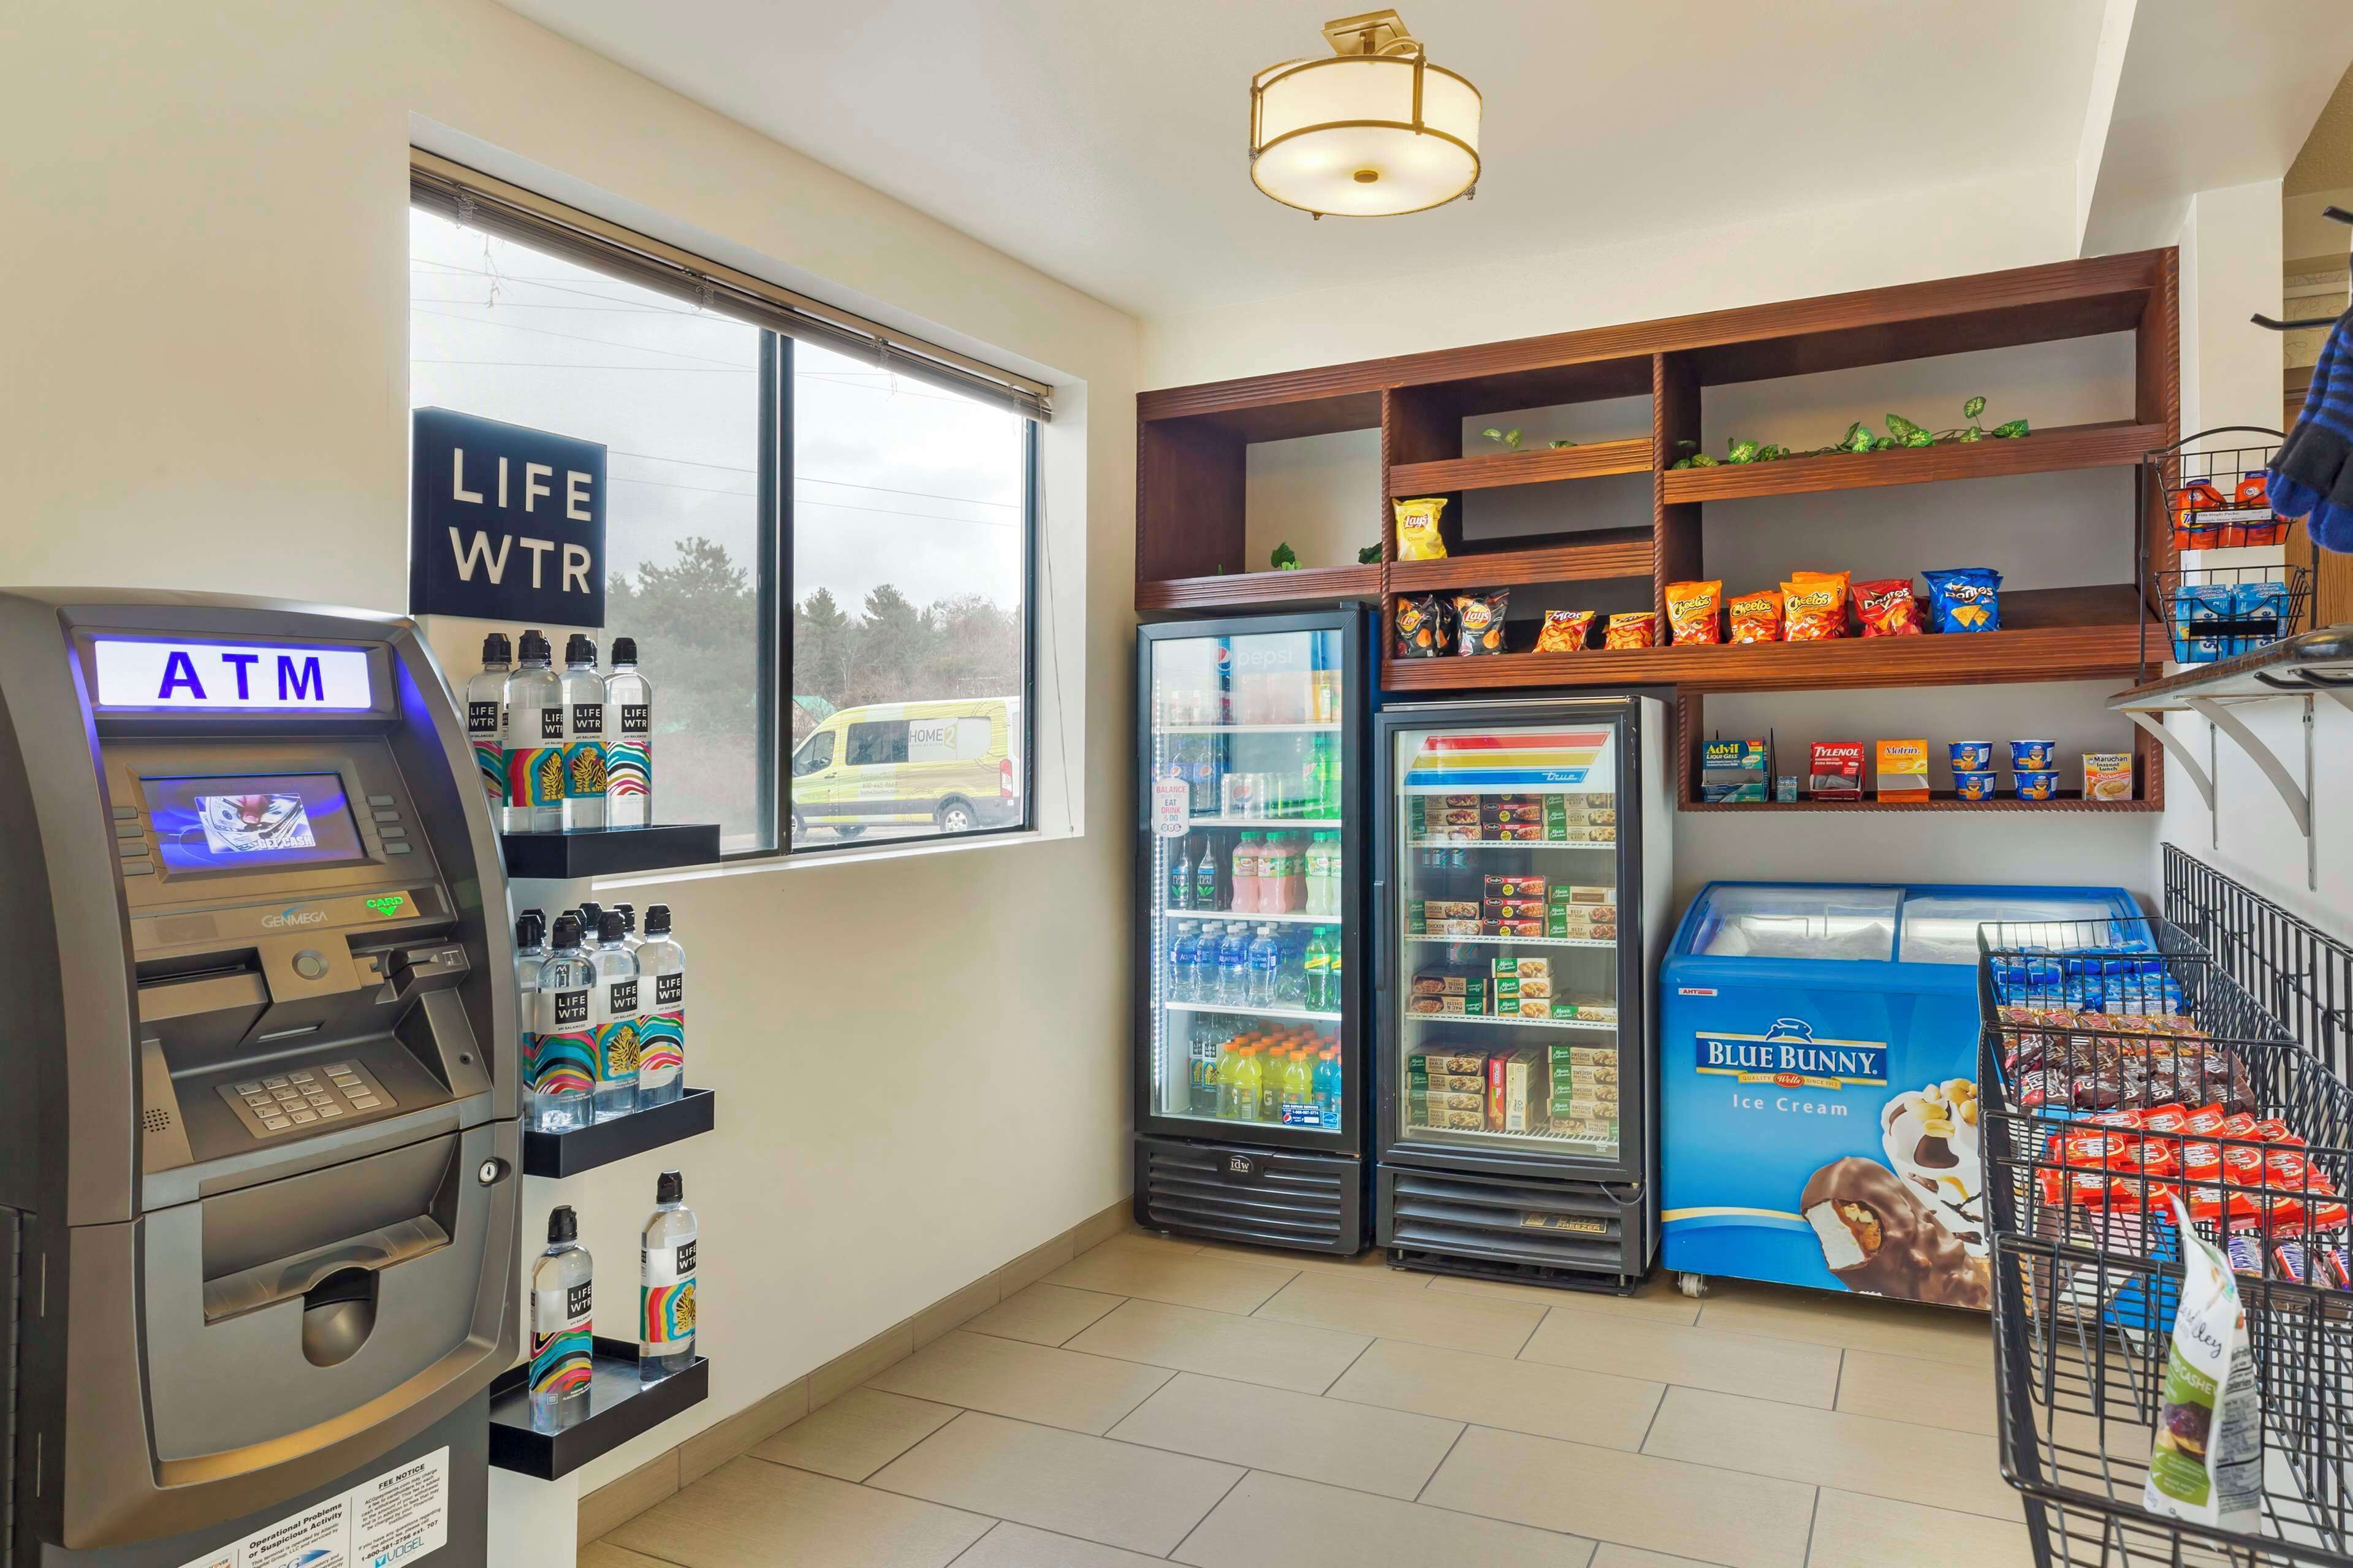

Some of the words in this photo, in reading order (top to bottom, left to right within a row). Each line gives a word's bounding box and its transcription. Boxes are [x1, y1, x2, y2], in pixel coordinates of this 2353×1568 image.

[454, 447, 592, 522] LIFE
[449, 525, 592, 594] WTR
[1864, 587, 1910, 611] Doritos
[1945, 585, 1993, 599] Doritos
[1671, 595, 1711, 622] Cheetos
[1731, 599, 1773, 617] Cheetos
[1786, 592, 1829, 612] Cheetos
[1237, 650, 1292, 669] pepsi
[158, 651, 324, 702] ATM
[470, 706, 495, 716] LIFE
[576, 709, 601, 718] LIFE
[624, 709, 647, 718] LIFE
[470, 718, 495, 726] WTR
[624, 719, 647, 728] WTR
[1706, 744, 1739, 754] Advil
[1814, 747, 1859, 757] TYLENOL
[1884, 745, 1918, 755] Motrin
[1541, 771, 1578, 780] true
[257, 838, 282, 848] GET
[281, 835, 316, 847] CASH
[367, 896, 403, 908] CARD
[261, 910, 328, 929] GENMEGA
[659, 978, 682, 989] LIFE
[614, 985, 637, 997] LIFE
[659, 989, 681, 1000] WTR
[558, 995, 586, 1007] LIFE
[614, 997, 637, 1008] WTR
[558, 1008, 586, 1019] WTR
[1707, 1041, 1774, 1069] BLUE
[1777, 1075, 1801, 1085] Wells
[1733, 1094, 1764, 1110] Ice
[1776, 1097, 1848, 1116] Cream
[1557, 1222, 1600, 1231] FREEZER
[679, 1245, 696, 1259] LIFE
[571, 1284, 591, 1301] LIFE
[571, 1298, 591, 1313] WTR
[378, 1478, 393, 1489] FEE
[396, 1463, 425, 1481] NOTICE
[422, 1468, 437, 1479] charge
[426, 1477, 439, 1486] added
[378, 1503, 395, 1514] amount
[414, 1483, 438, 1496] withdrawal
[387, 1484, 414, 1499] cardholders
[383, 1505, 402, 1517] addition
[249, 1520, 300, 1550] Operational
[303, 1501, 342, 1524] Problems
[374, 1515, 393, 1527] charged
[395, 1518, 418, 1532] questions
[419, 1507, 441, 1521] regarding
[249, 1550, 257, 1559] or
[260, 1526, 307, 1554] Suspicious
[310, 1510, 342, 1531] Activity
[311, 1531, 330, 1543] serviced
[361, 1533, 411, 1561] 1-800-381-2756
[412, 1526, 424, 1536] ext.
[427, 1520, 438, 1529] 707
[380, 1536, 394, 1545] above
[405, 1523, 419, 1533] please
[251, 1558, 262, 1566] This
[264, 1547, 284, 1560] terminal
[291, 1534, 312, 1548] operated
[321, 1522, 338, 1533] Atlantic
[387, 1534, 424, 1562] VOGEL
